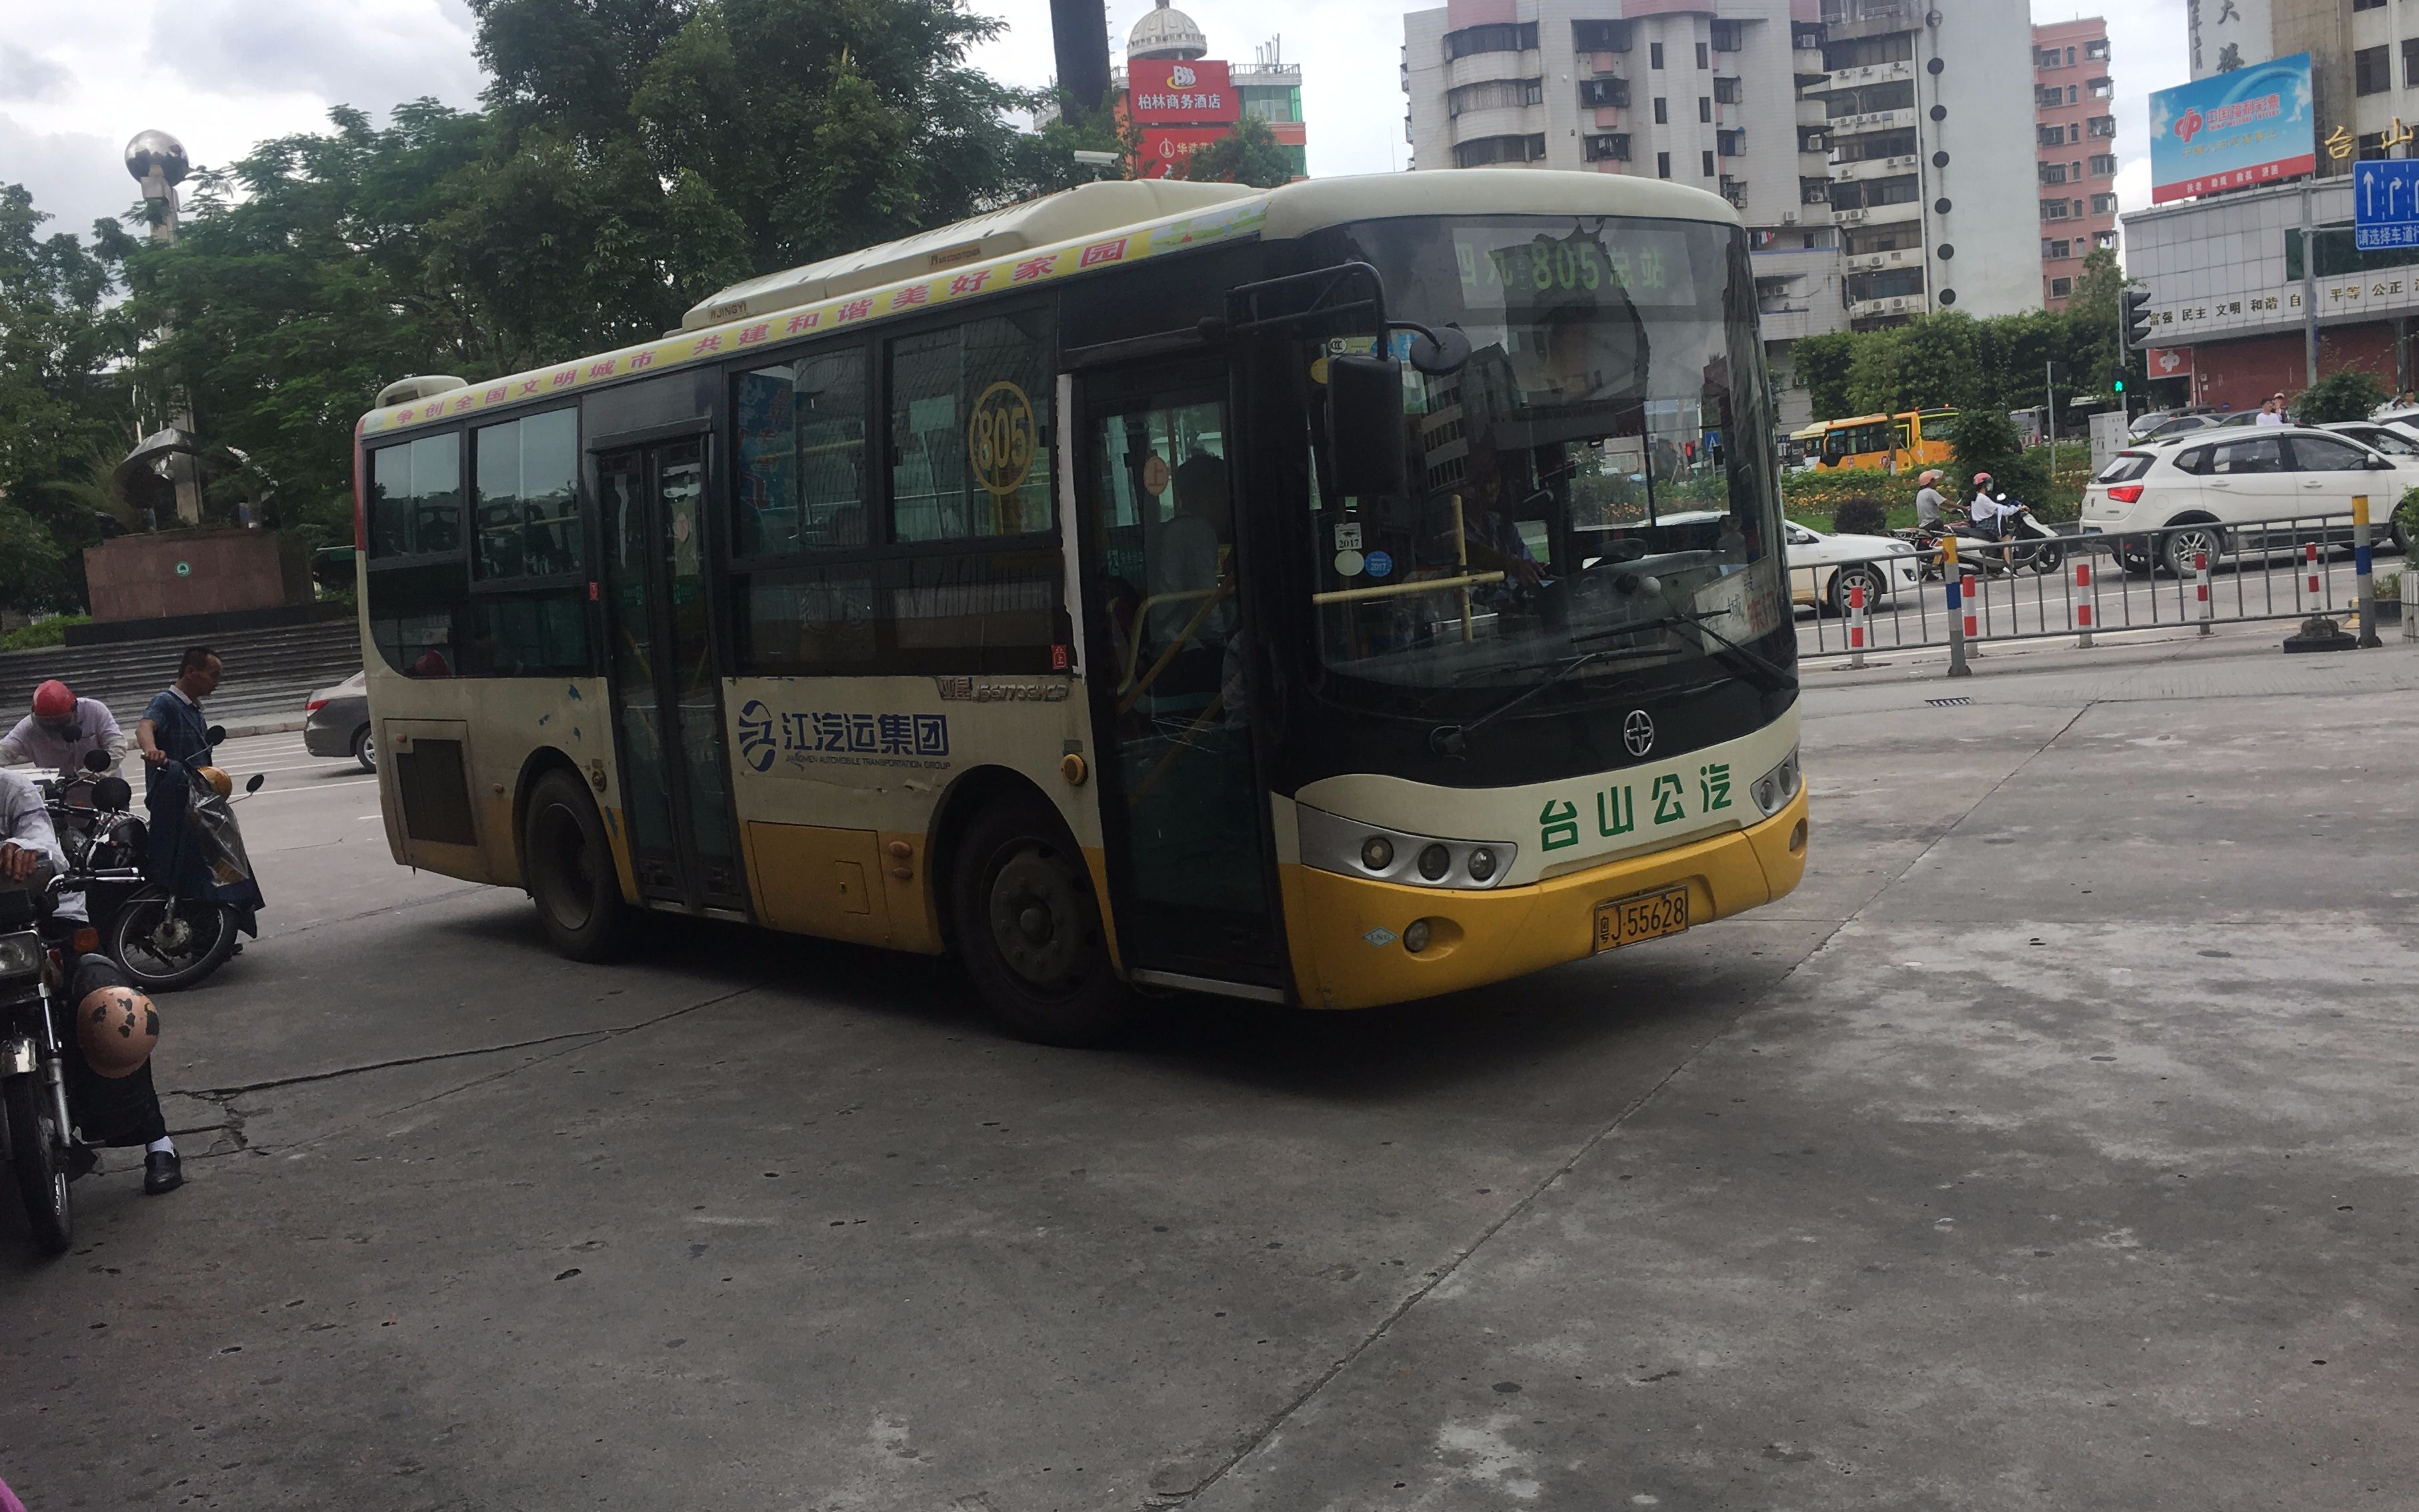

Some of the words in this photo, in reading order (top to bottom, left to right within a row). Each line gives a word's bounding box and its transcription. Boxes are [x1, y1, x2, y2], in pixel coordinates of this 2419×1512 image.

[1138, 93, 1220, 110] 柏林商务酒店
[2206, 93, 2280, 123] 中国福利彩票
[2324, 116, 2414, 159] 台山
[1532, 241, 1600, 290] 805
[716, 302, 747, 318] JINGYI
[2148, 308, 2174, 327] 富强
[2182, 307, 2207, 321] 民主
[2215, 301, 2241, 315] 文明
[2251, 296, 2278, 312] 和谐
[2330, 284, 2360, 302] 平等
[2372, 281, 2403, 297] 公正
[395, 350, 657, 425] 争创全国文明城市
[693, 238, 1127, 355] 共建和谐美好家园
[977, 406, 1026, 470] 805
[1147, 462, 1164, 487] 上
[1338, 539, 1360, 549] 2017
[781, 712, 950, 757] 江汽运集团
[819, 756, 861, 765] AUTOMOBILE
[862, 758, 923, 769] TRANSPORTATION
[923, 761, 951, 769] GROUP
[1540, 762, 1732, 852] 台山公汽
